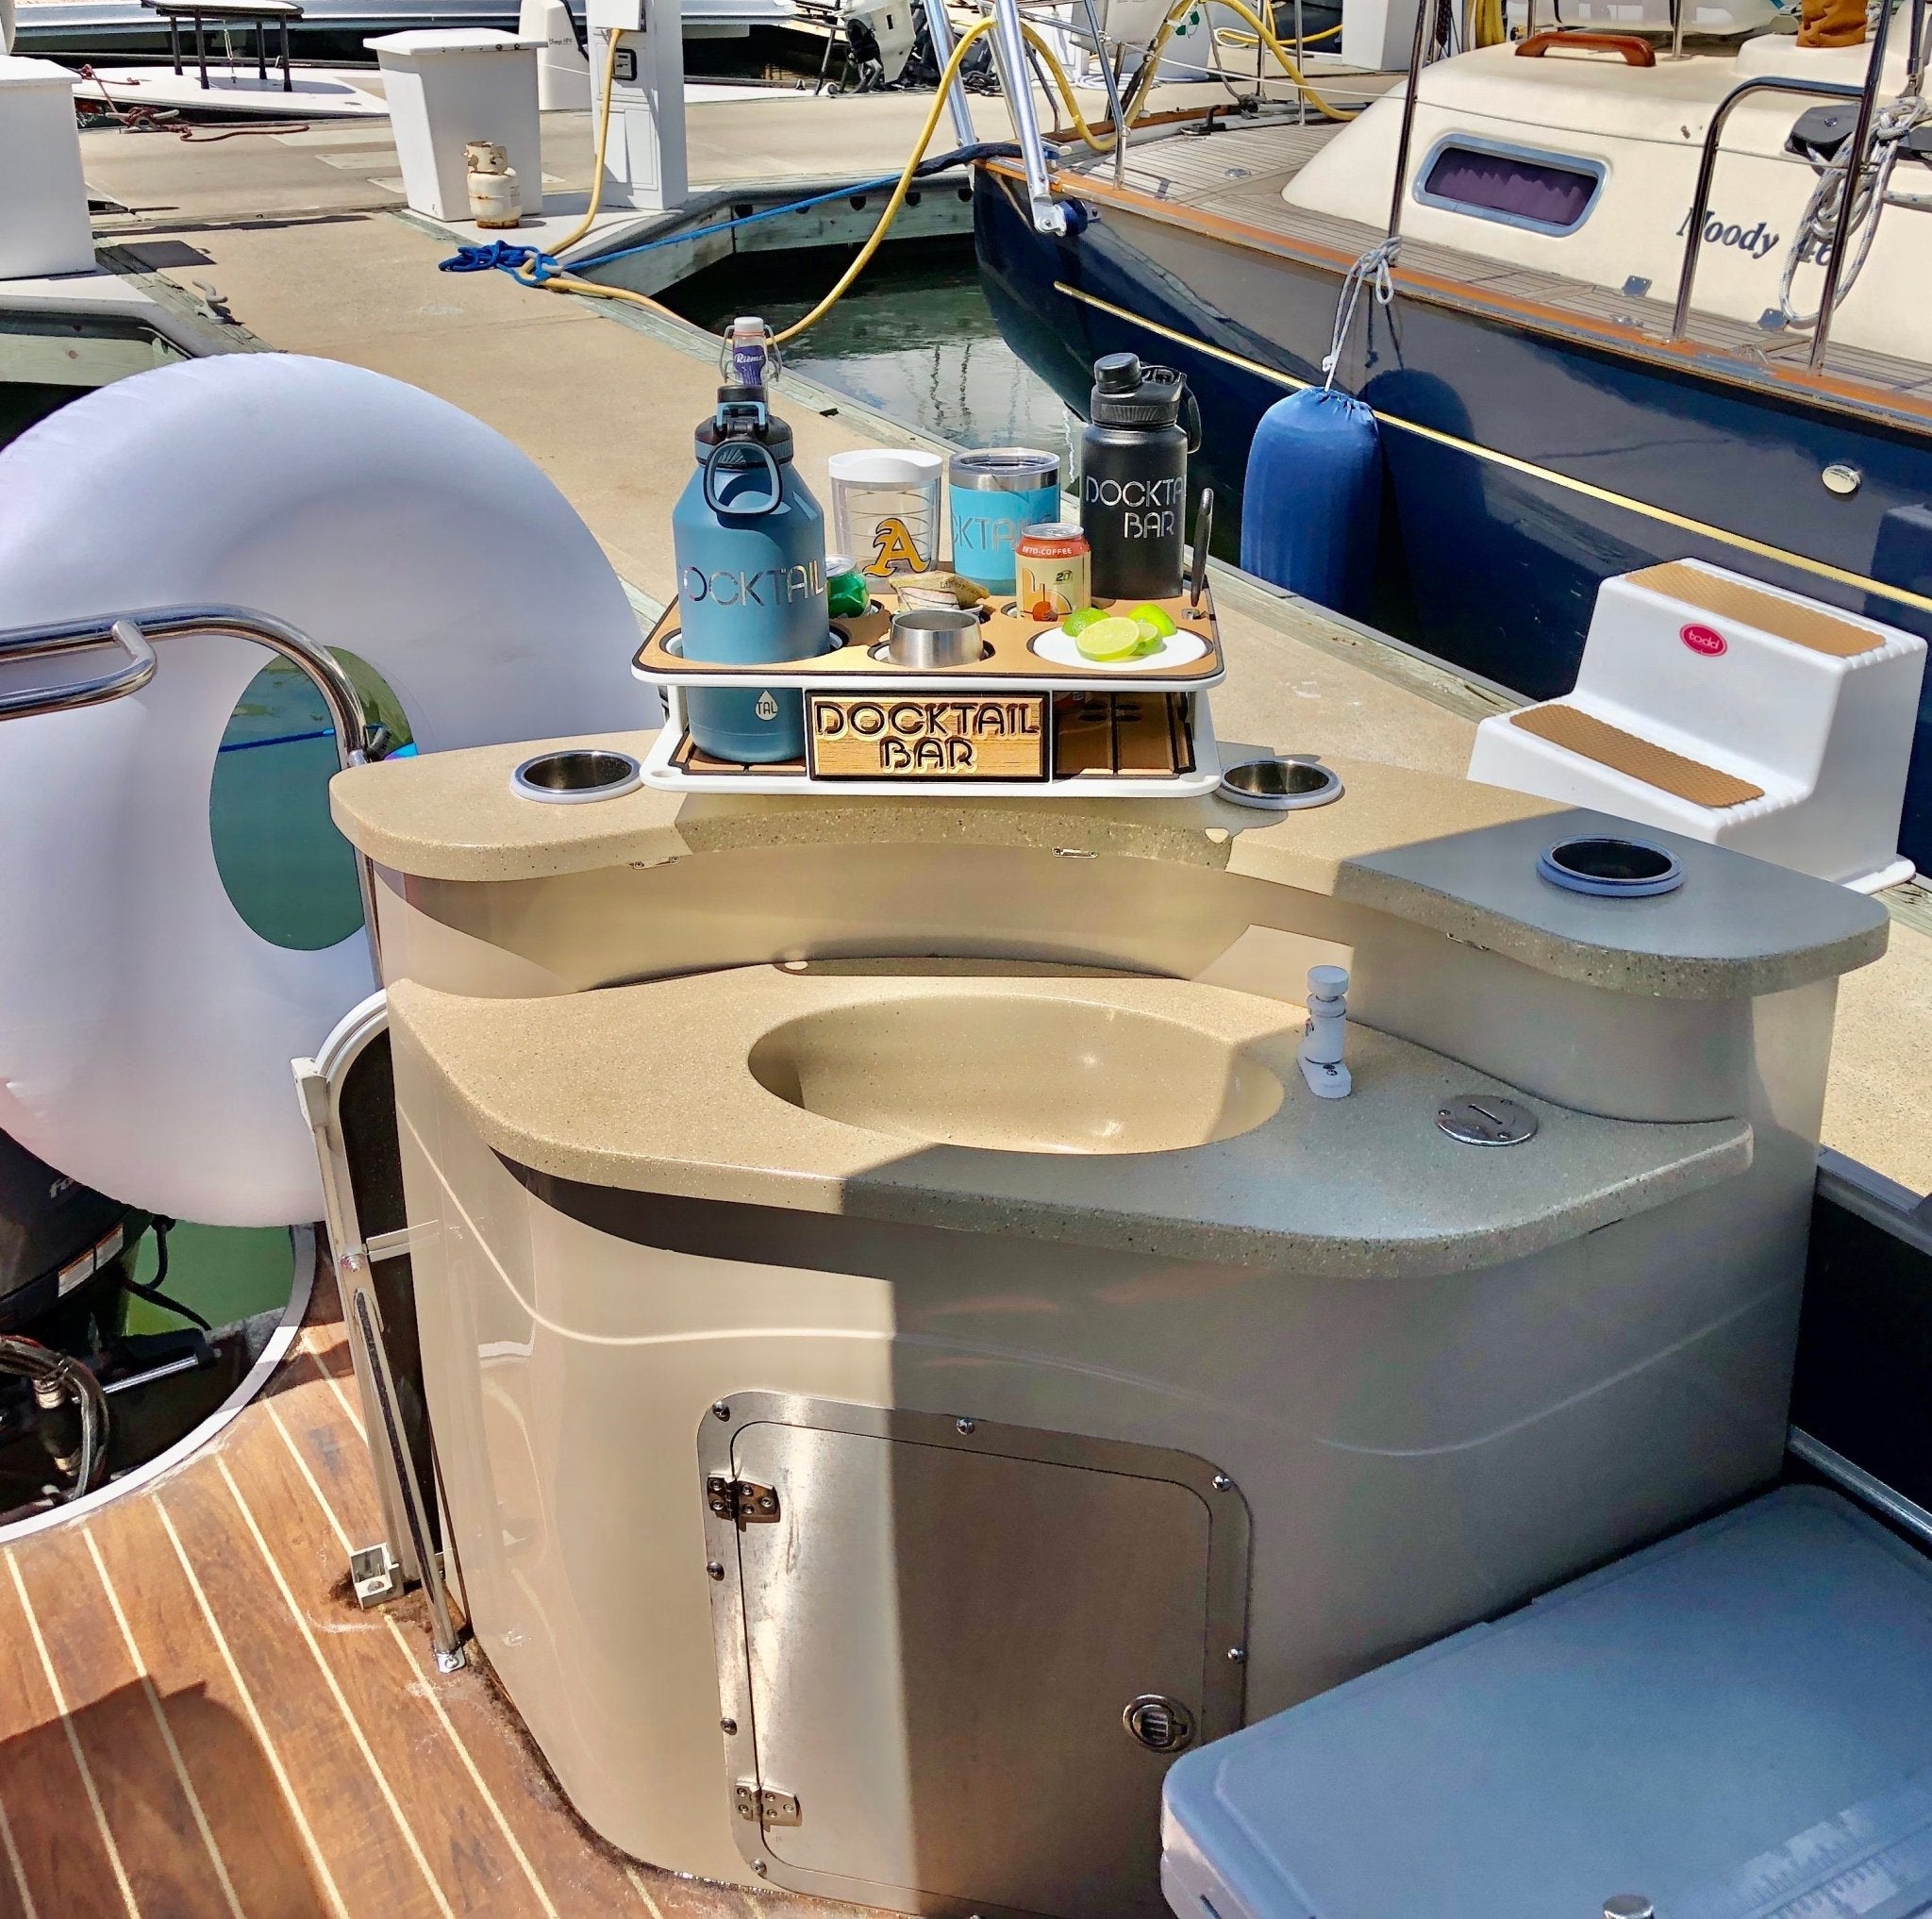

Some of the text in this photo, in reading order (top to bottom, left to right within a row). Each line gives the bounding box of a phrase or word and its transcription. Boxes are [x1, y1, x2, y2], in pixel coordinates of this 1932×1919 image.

[1124, 510, 1174, 539] BAR
[862, 517, 932, 578] A
[1688, 629, 1721, 650] todd
[758, 700, 778, 715] TAL
[815, 700, 1041, 737] DOCKTAIL
[879, 736, 975, 771] BAR
